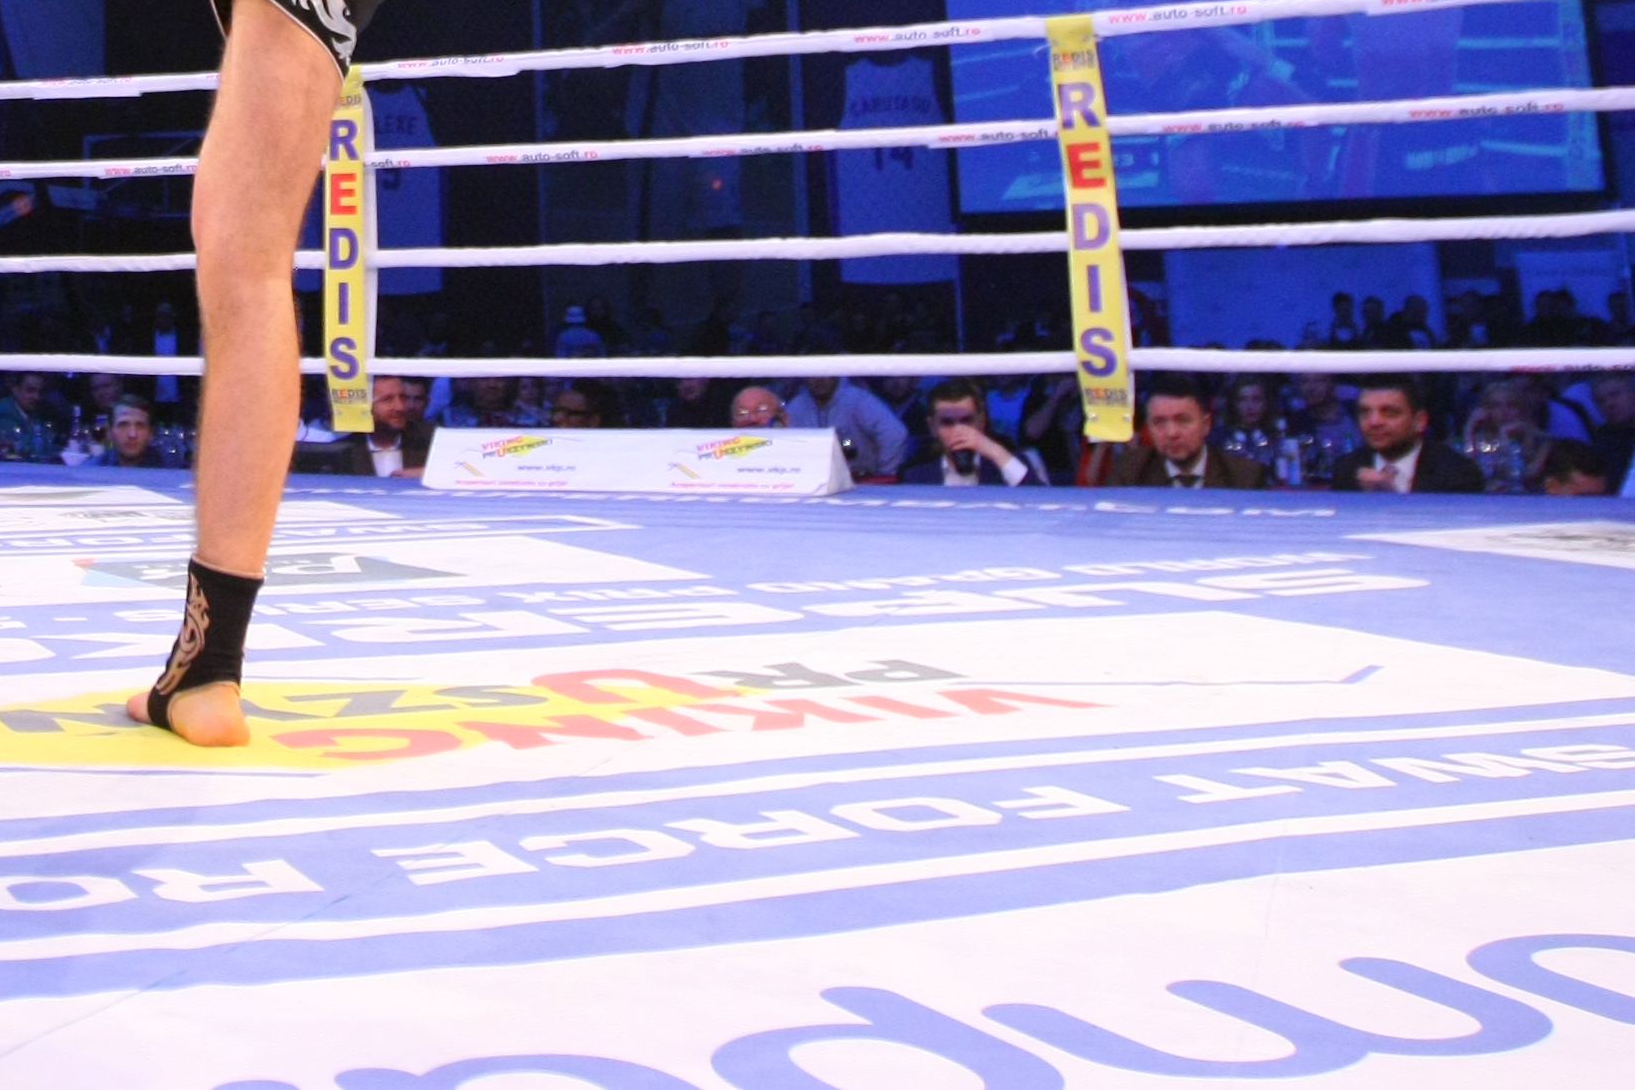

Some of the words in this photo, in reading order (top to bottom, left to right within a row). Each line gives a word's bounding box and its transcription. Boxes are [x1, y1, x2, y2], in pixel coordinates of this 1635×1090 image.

[1109, 6, 1247, 24] www.auto-soft.ro
[938, 128, 1058, 142] www.auto-soft.
[486, 150, 599, 163] www.auto-soft.ro
[1057, 81, 1118, 377] REDIS
[328, 118, 361, 380] REDIS
[272, 523, 489, 538] SWA
[497, 585, 740, 604] PRIX
[113, 595, 487, 623] SERIS
[268, 688, 1115, 761] VIKING
[1152, 743, 1635, 805] SWAT
[372, 785, 1131, 888] FORCE
